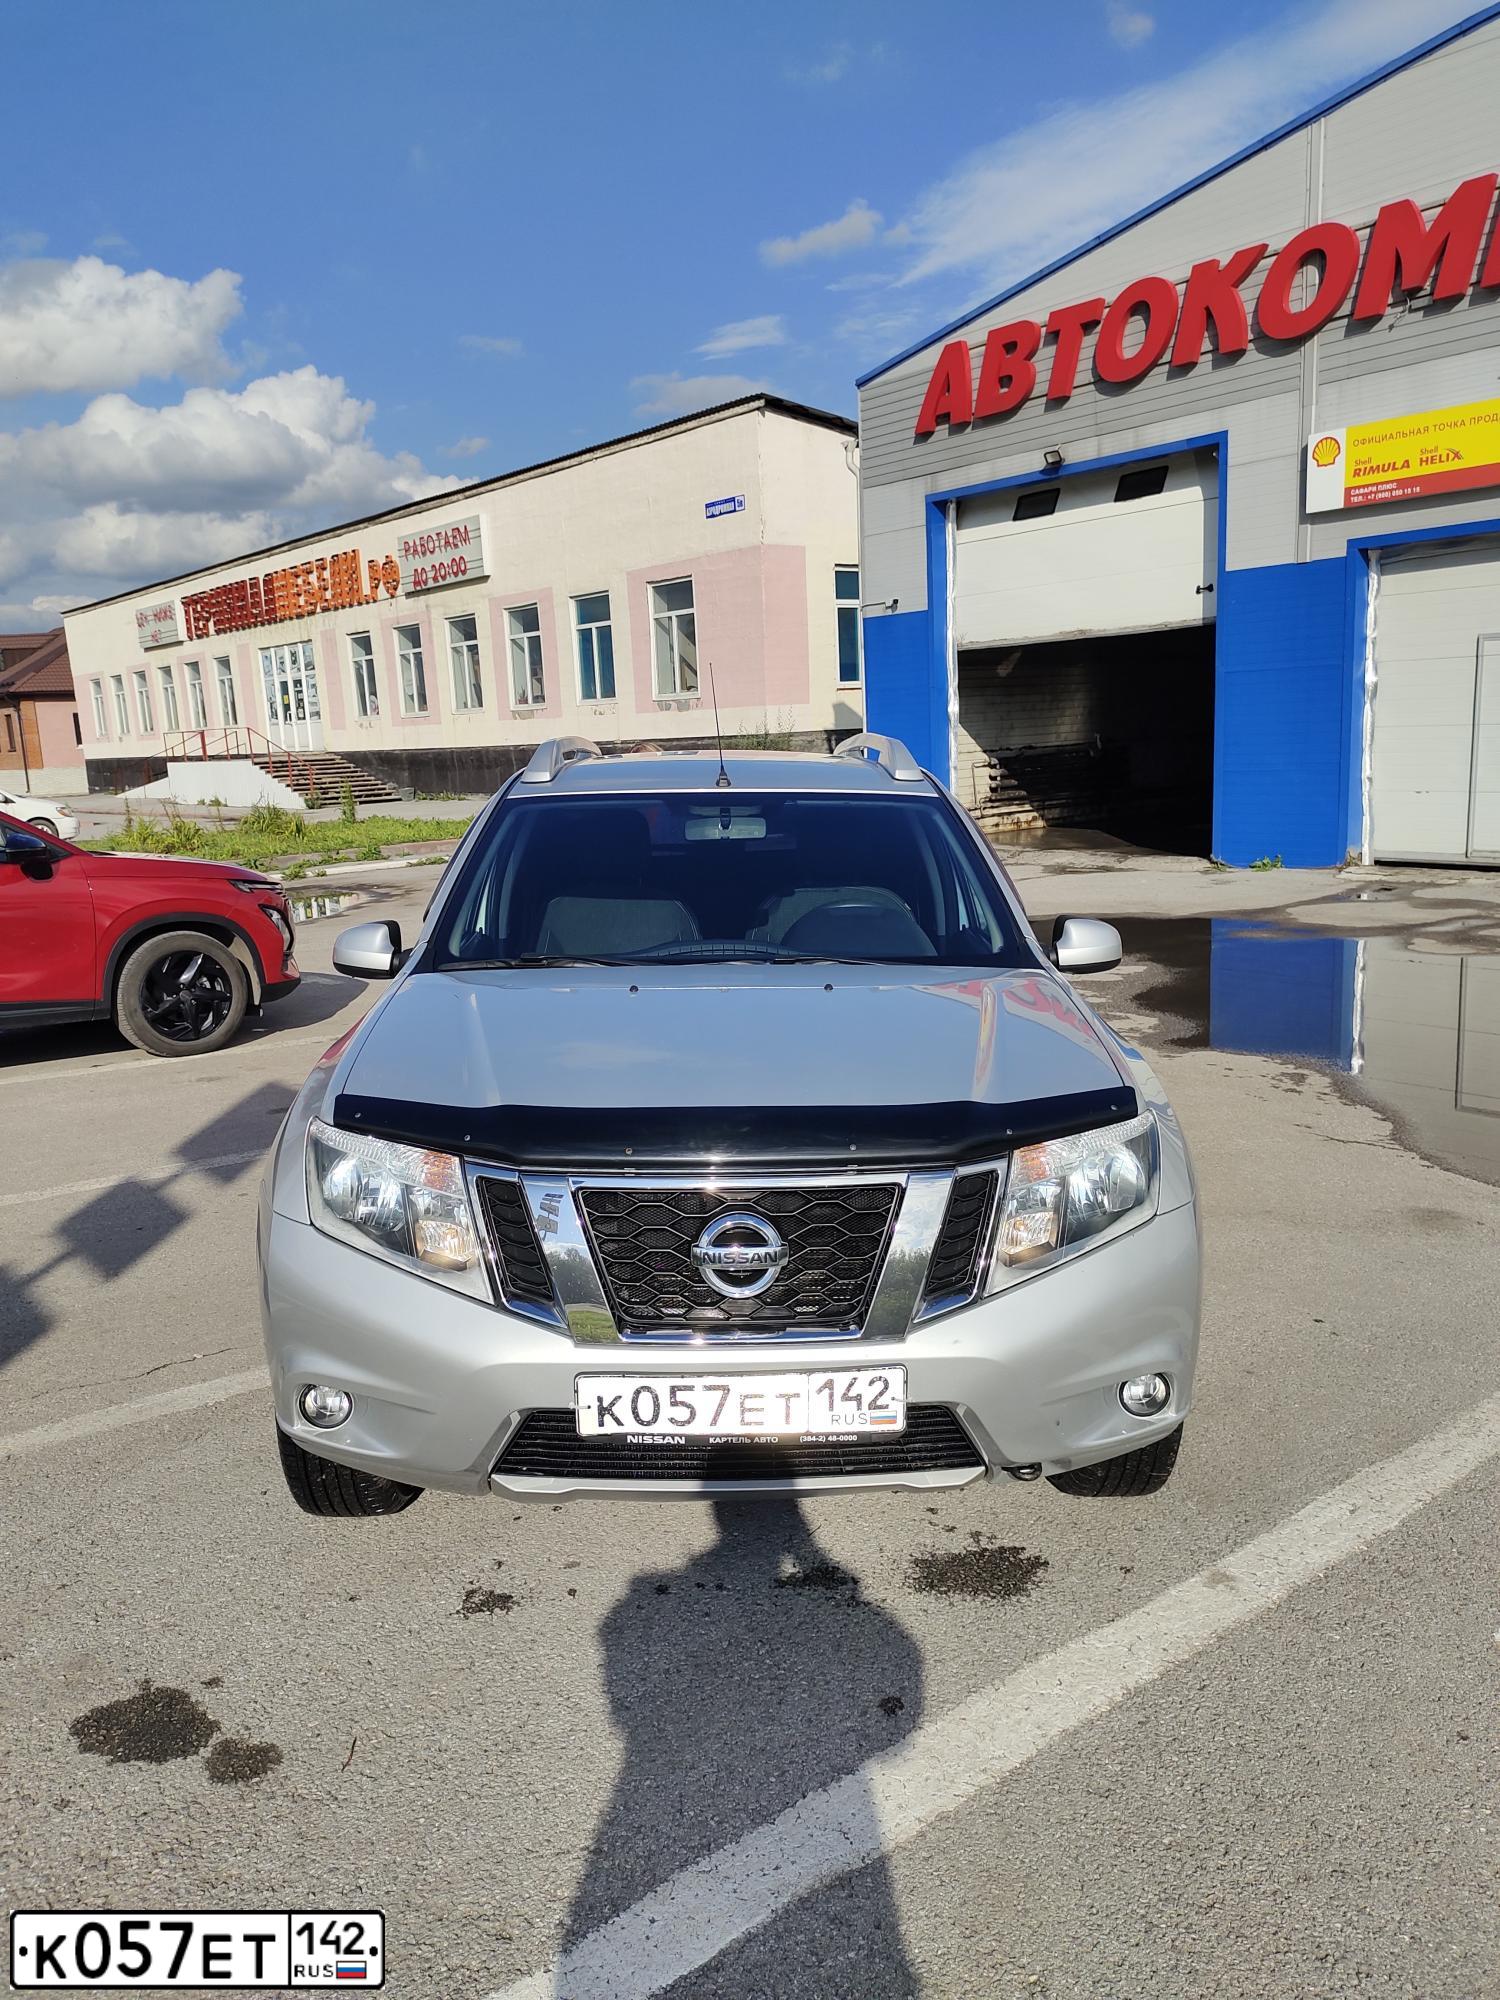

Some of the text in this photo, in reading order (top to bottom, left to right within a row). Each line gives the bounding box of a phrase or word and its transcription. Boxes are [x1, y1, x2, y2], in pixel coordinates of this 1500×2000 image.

[914, 172, 1500, 435] АВТОКОМ
[1352, 412, 1500, 448] ОФИЦИАЛЬНАЯ ТОЧКА ПРОД
[1419, 446, 1438, 456] Shell
[1419, 448, 1464, 467] HELIX
[1352, 459, 1411, 478] RIMULA
[1354, 457, 1372, 467] Shell
[1350, 484, 1377, 496] САФАРИ
[1378, 482, 1398, 491] ПЛЮС
[403, 524, 471, 562] РАБОТАЕМ
[412, 555, 467, 591] ДО 20:00
[701, 1250, 779, 1266] NISSAN
[815, 1375, 892, 1412] 142
[830, 1411, 868, 1426] RUS
[626, 1434, 686, 1445] NISSAN
[708, 1435, 779, 1445] КАРТЕЛЬ АВТО
[799, 1433, 858, 1444] (384-2) 48-0000
